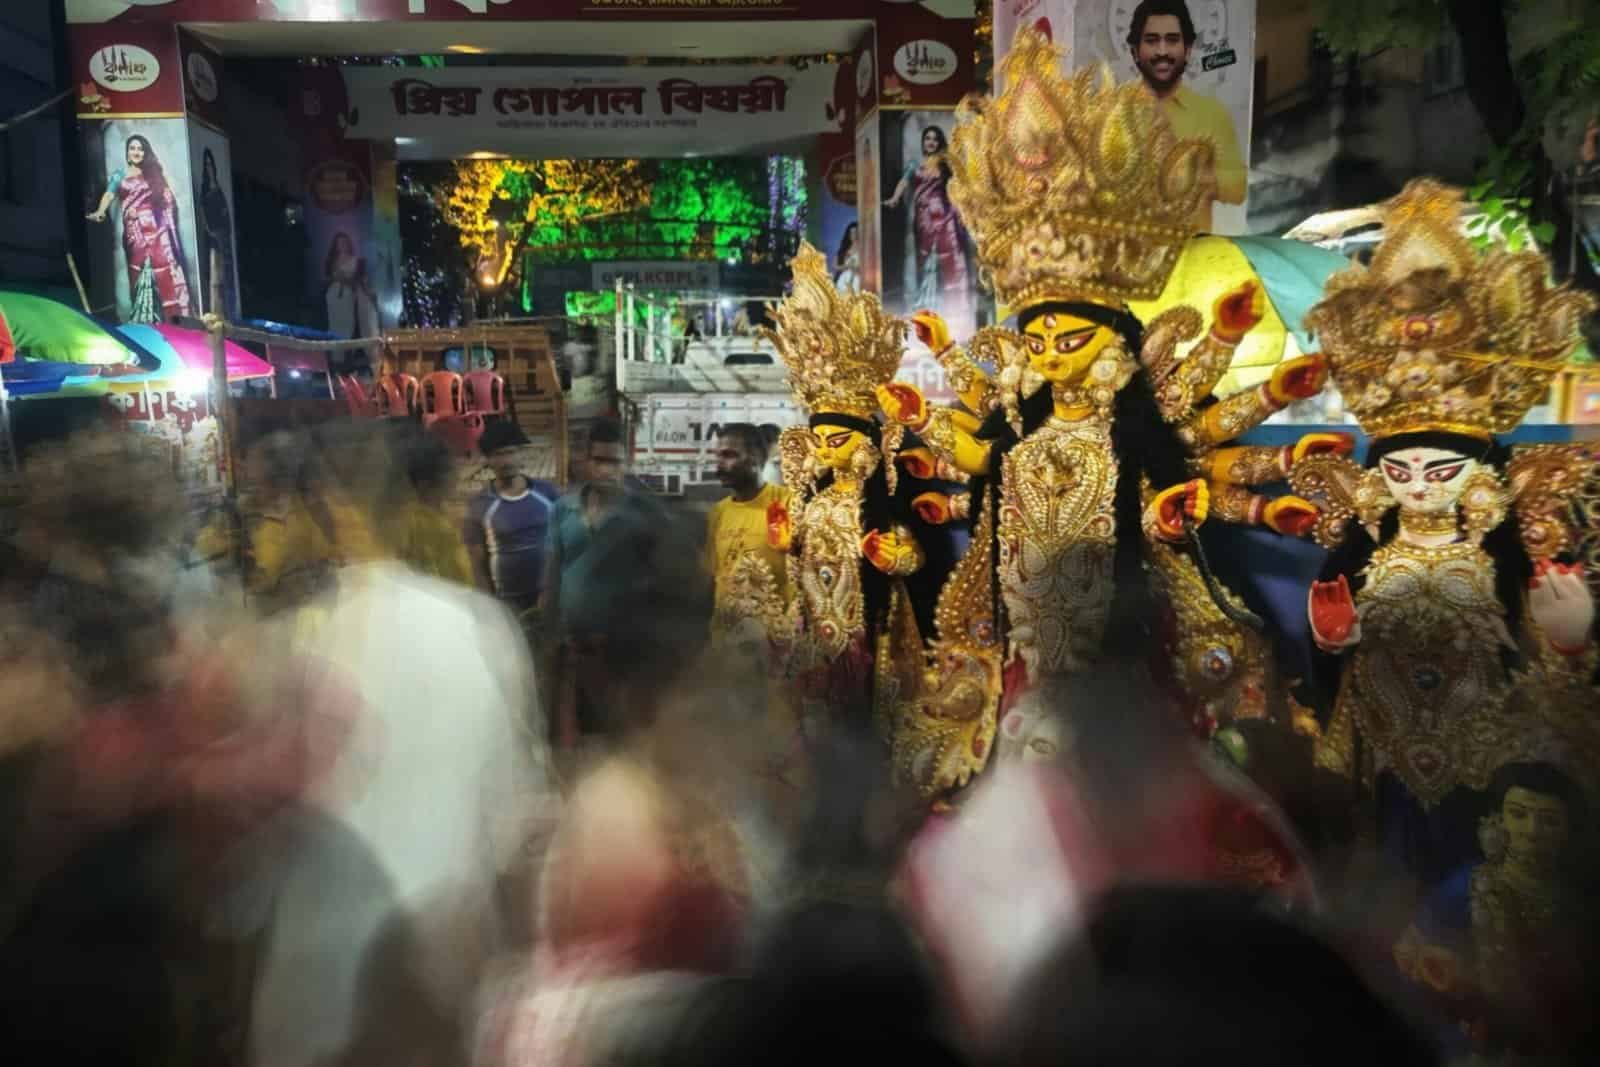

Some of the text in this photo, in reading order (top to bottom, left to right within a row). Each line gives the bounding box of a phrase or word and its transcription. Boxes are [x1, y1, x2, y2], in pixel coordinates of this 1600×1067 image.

[391, 75, 787, 117] প্রিয় গোপাল বিষয়ী
